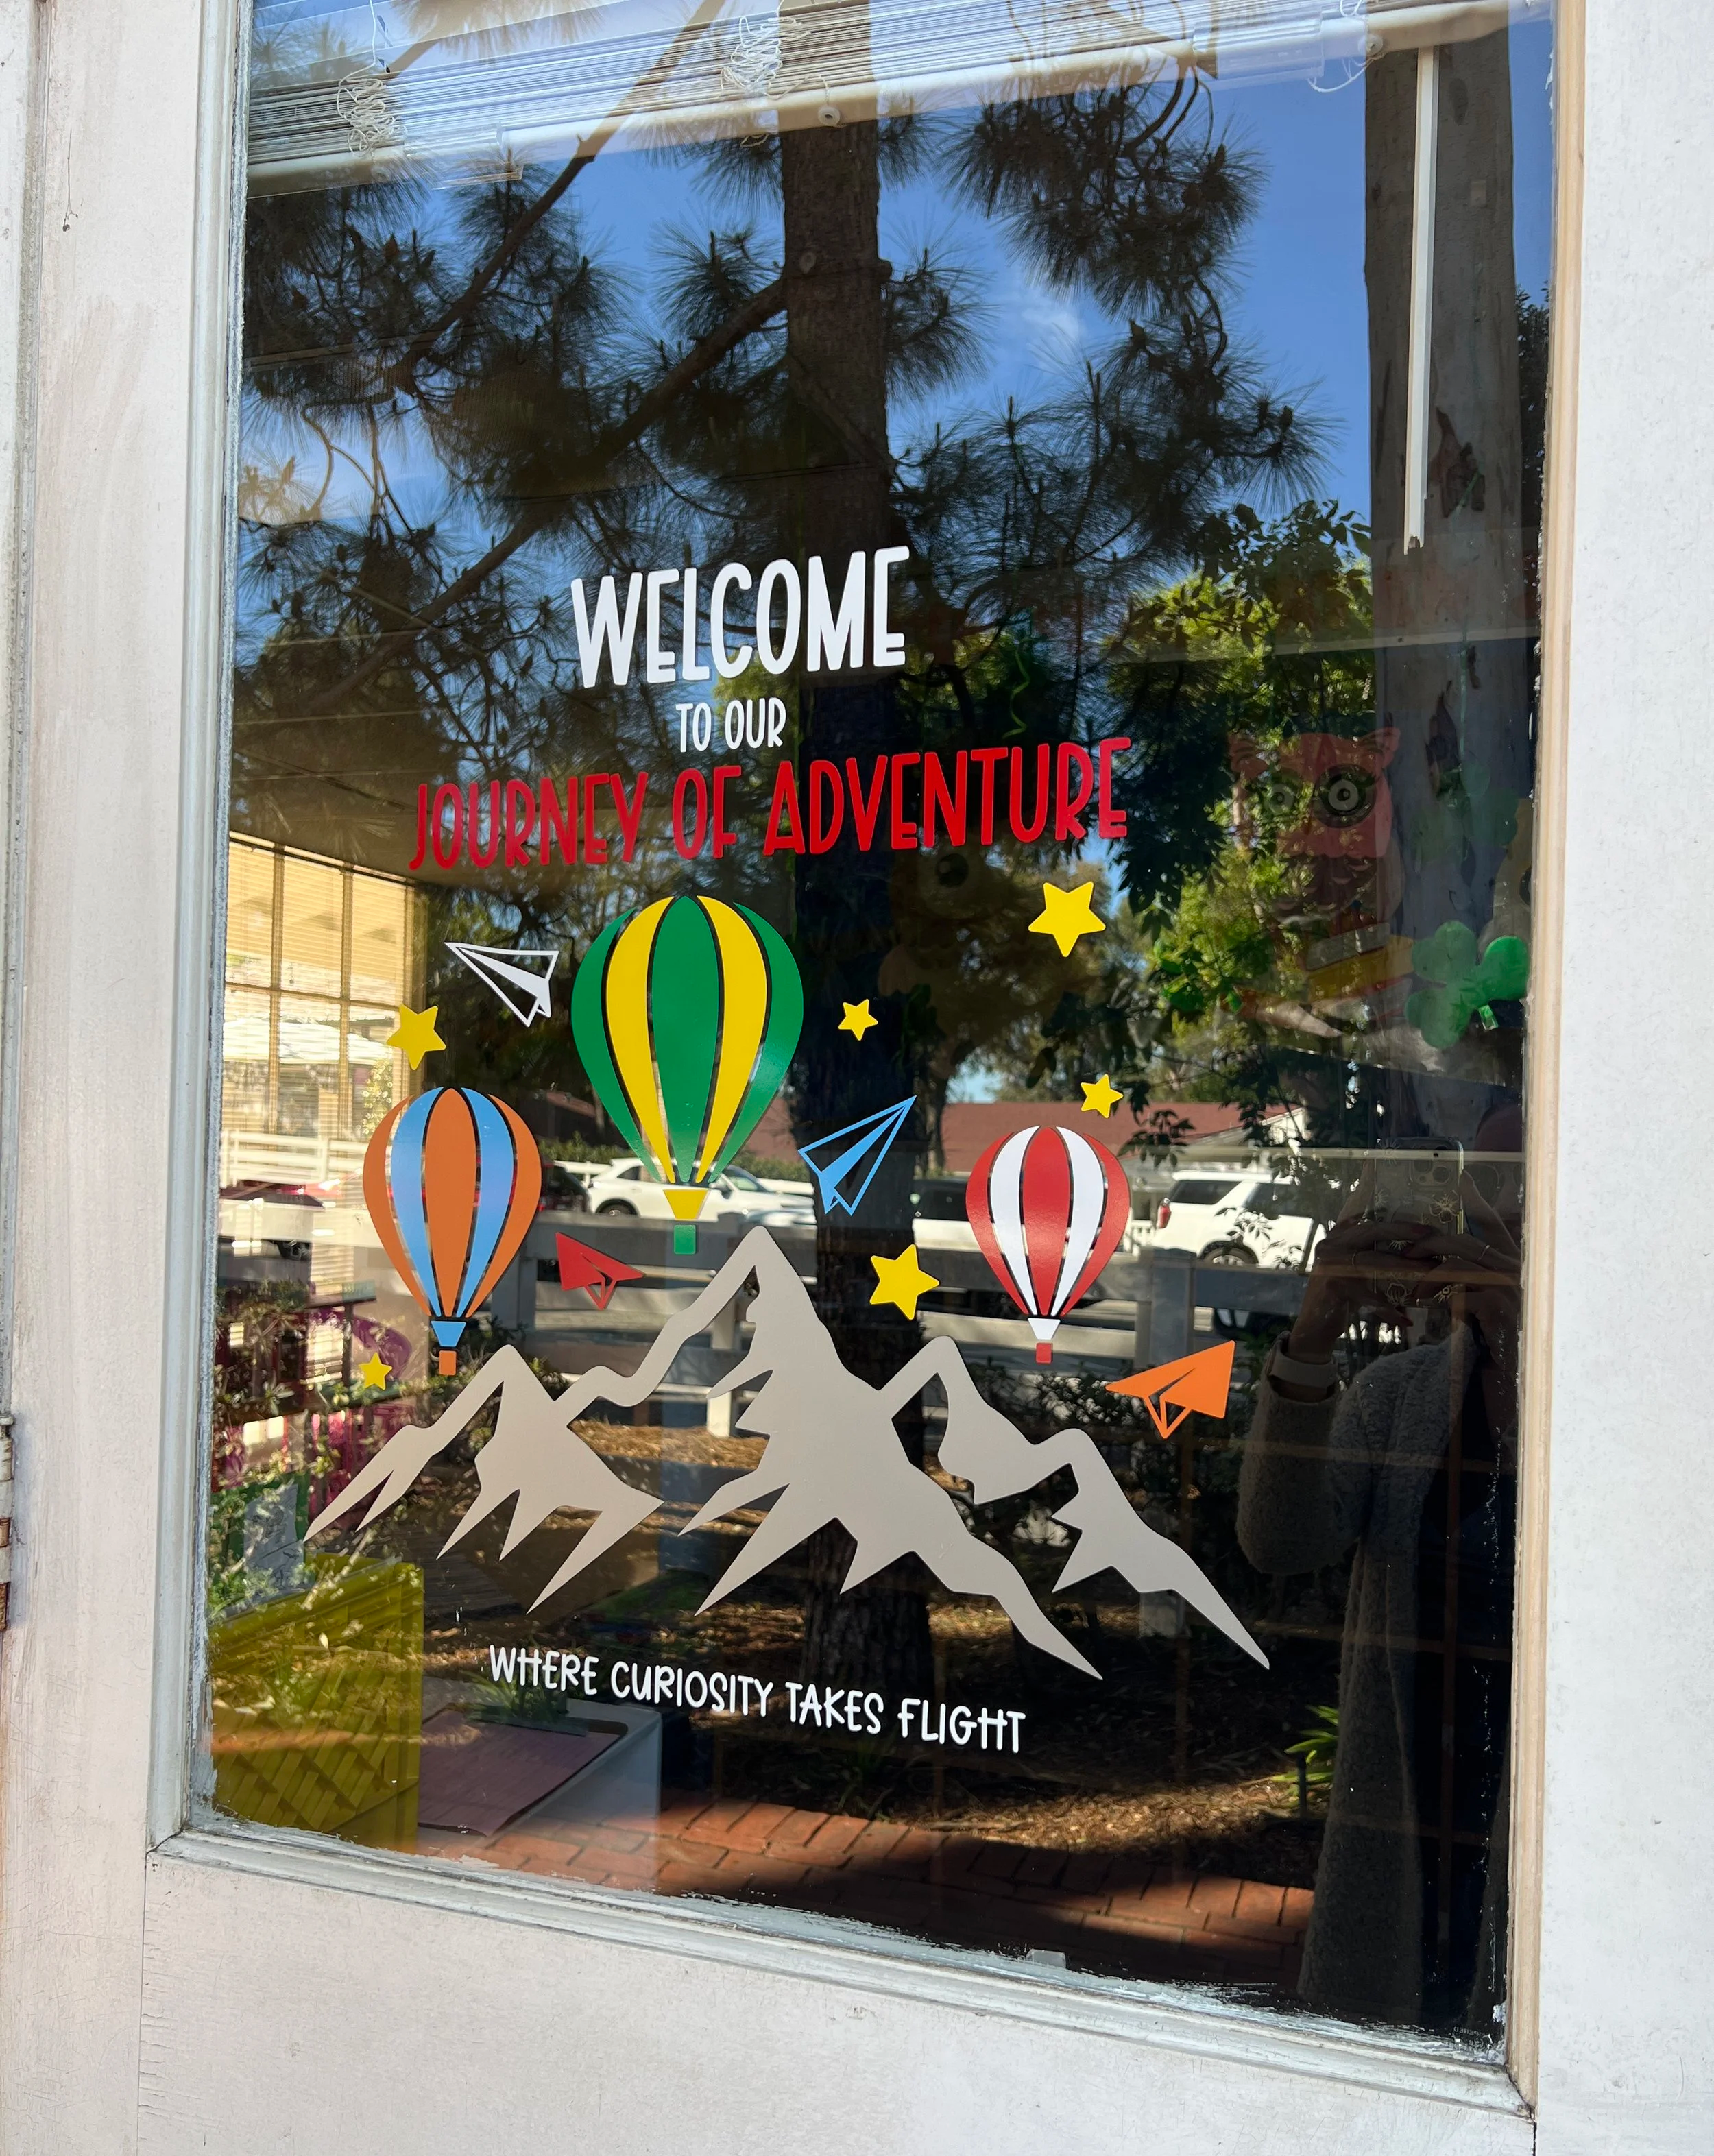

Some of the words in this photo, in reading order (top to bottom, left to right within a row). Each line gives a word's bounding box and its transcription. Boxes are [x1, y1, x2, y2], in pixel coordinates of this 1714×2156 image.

[570, 545, 910, 689] WELCOME
[675, 701, 712, 753] TO
[724, 697, 787, 749] OUR
[408, 771, 649, 873] JOURNEY
[671, 764, 743, 861] OF
[762, 736, 1132, 856] ADVENTURE
[489, 1644, 600, 1696] WHERE
[610, 1660, 774, 1717] CURIOSITY
[784, 1681, 884, 1734] TAKES
[897, 1697, 1026, 1754] FLIGHT
